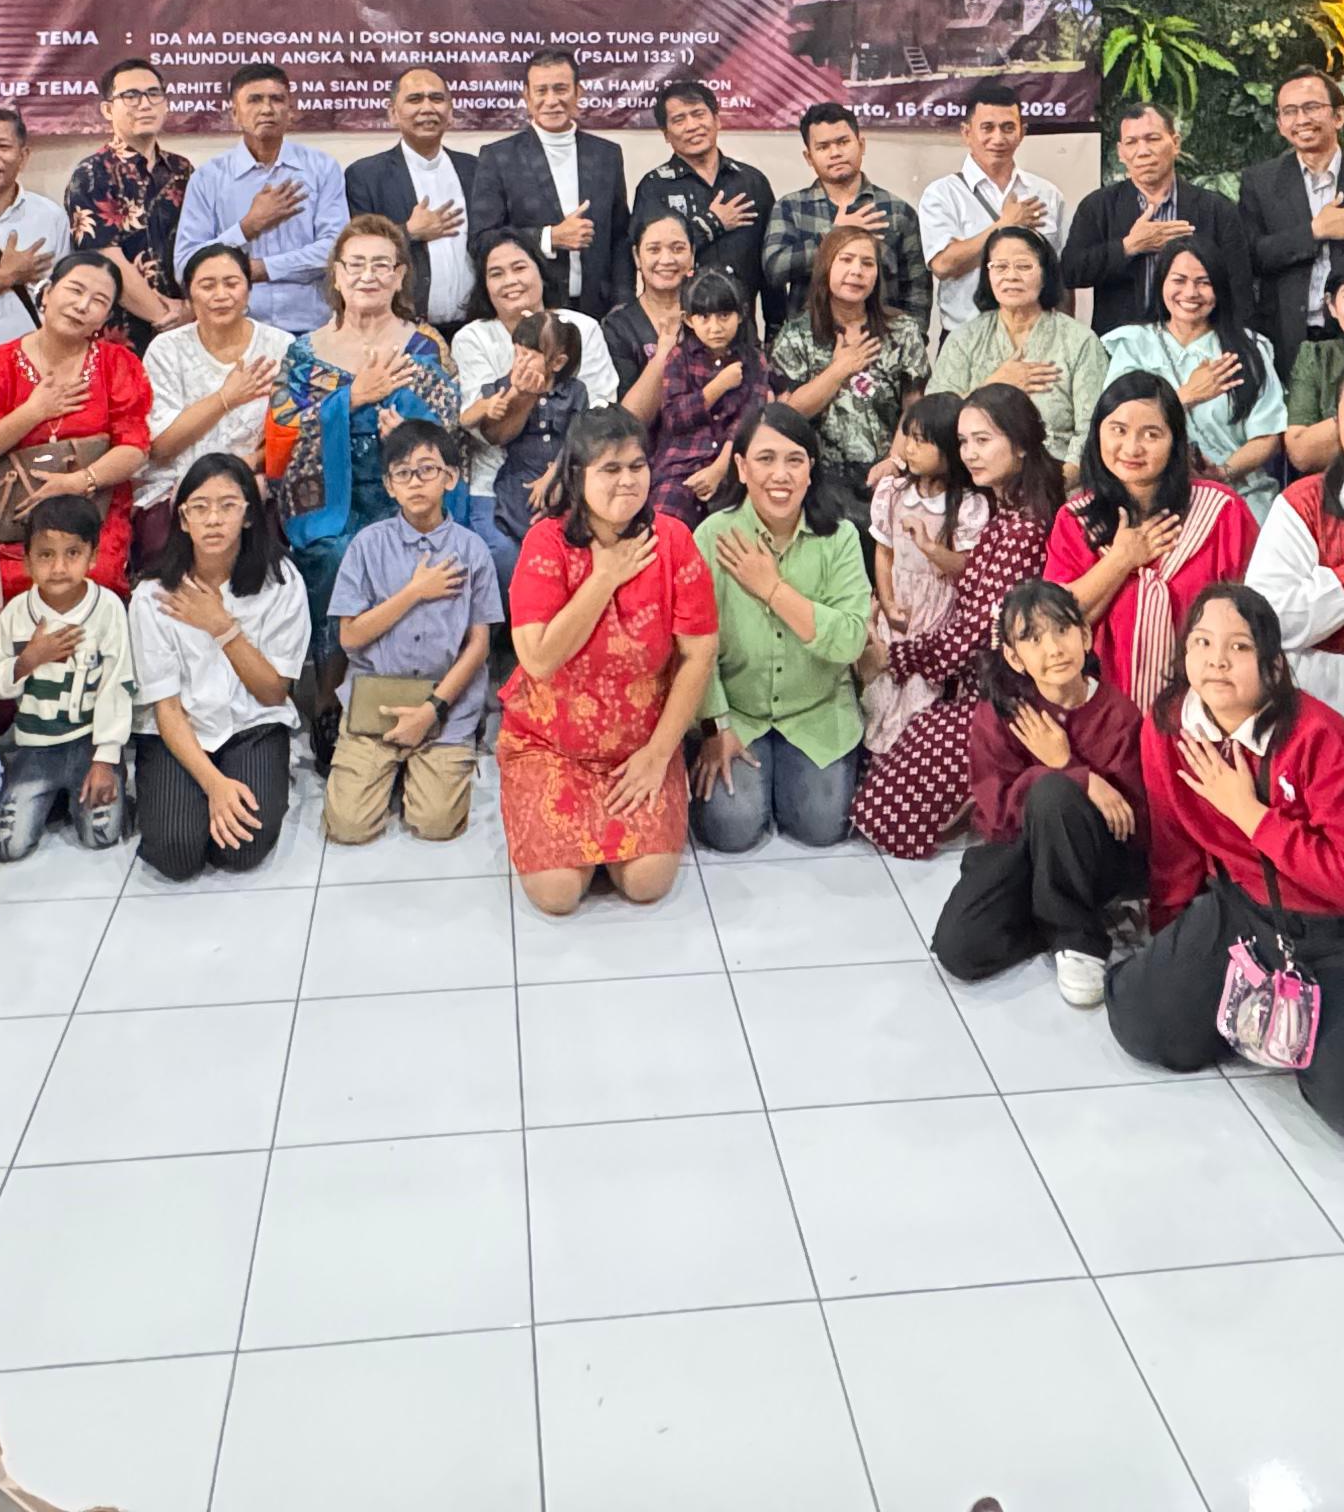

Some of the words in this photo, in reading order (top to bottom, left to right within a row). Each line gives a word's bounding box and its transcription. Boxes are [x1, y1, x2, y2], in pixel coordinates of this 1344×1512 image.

[36, 30, 99, 46] TEMA
[150, 31, 181, 46] IDA
[187, 31, 216, 45] MA
[222, 31, 312, 45] DENGGAN
[318, 31, 343, 45] NA
[349, 31, 355, 44] I
[359, 31, 423, 45] DOHOT
[428, 31, 505, 44] SONANG
[510, 31, 543, 47] NAI,
[550, 31, 601, 45] MOLO
[605, 31, 654, 45] TUNG
[659, 31, 720, 45] PUNGU
[150, 50, 275, 66] SAHUNDULAN
[281, 50, 344, 65] ANGKA
[351, 50, 376, 64] NA
[573, 48, 638, 67] (PSALM
[643, 50, 675, 64] 133:
[680, 48, 695, 66] 1)
[38, 80, 99, 96] TEMA
[165, 81, 223, 94] ARHITE
[302, 80, 326, 93] NA
[330, 80, 368, 92] SIAN
[609, 79, 660, 93] HAMU,
[896, 101, 917, 117] 16
[1021, 101, 1067, 117] 2026
